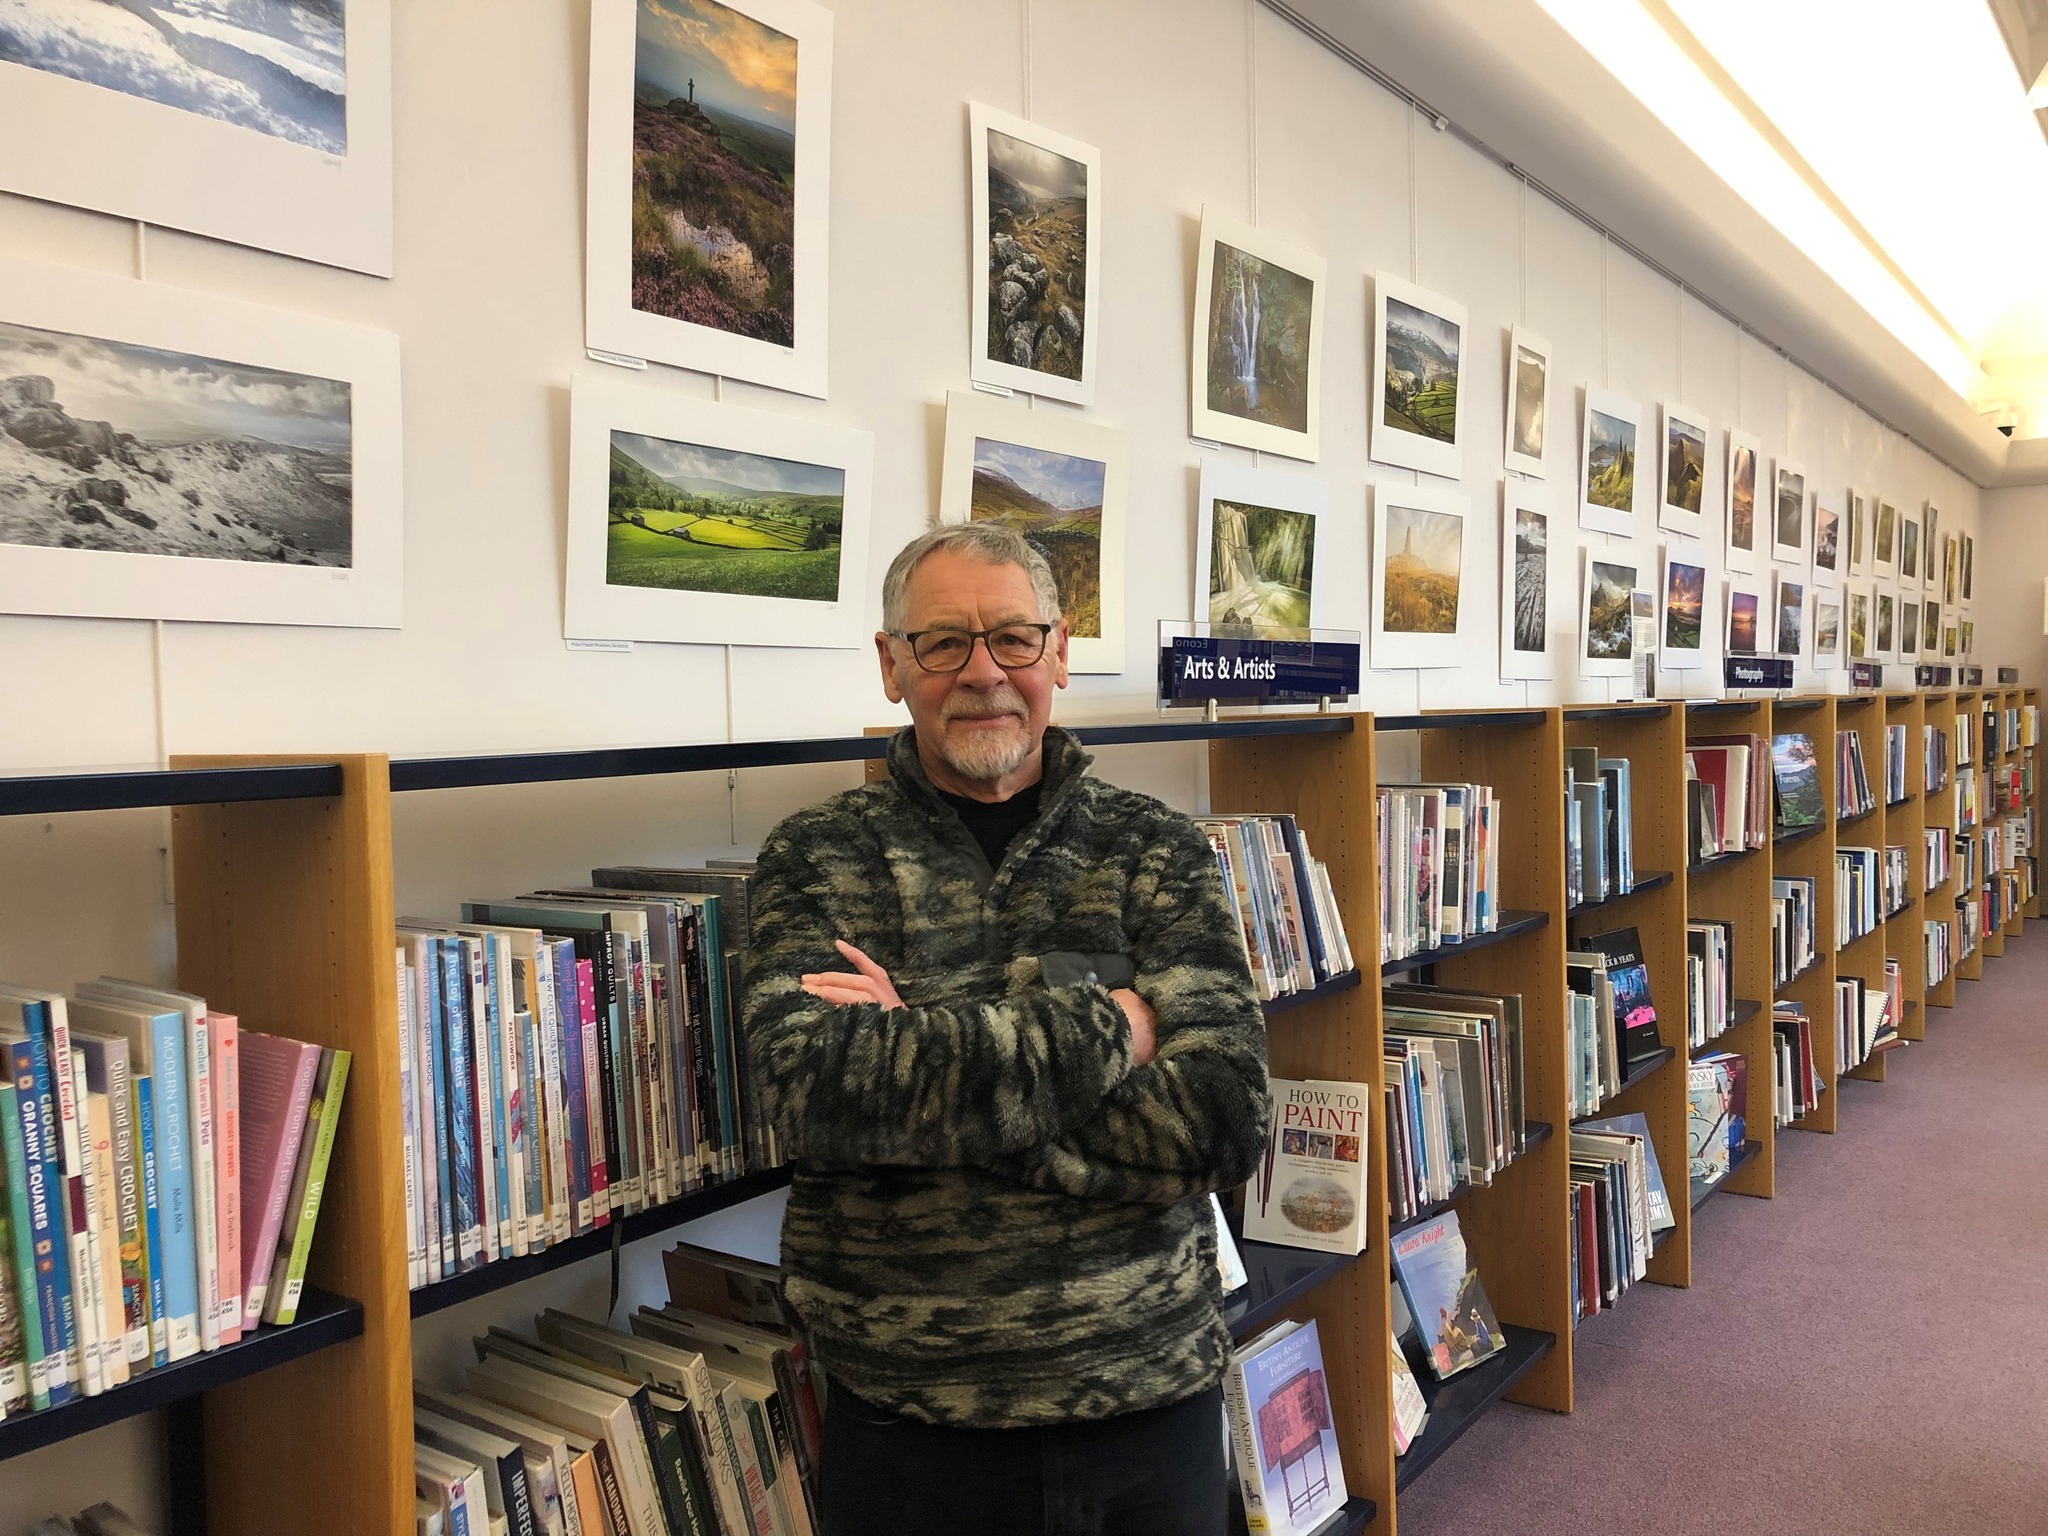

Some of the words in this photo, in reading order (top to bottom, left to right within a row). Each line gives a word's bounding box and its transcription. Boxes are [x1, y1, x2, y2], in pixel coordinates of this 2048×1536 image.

[1183, 656, 1214, 680] Arts
[1217, 656, 1230, 680] &
[1233, 656, 1276, 680] Artists
[1735, 666, 1764, 683] Photography
[1779, 775, 1800, 784] Forests
[429, 953, 438, 969] big
[448, 952, 459, 976] The
[605, 931, 613, 965] IMPROV
[1619, 953, 1636, 965] YEATS
[487, 953, 496, 977] LITTLE
[561, 959, 574, 992] Simple
[397, 962, 406, 1016] QUILTING
[431, 971, 440, 996] stitch
[449, 979, 460, 1001] Joy
[488, 979, 498, 1005] QUILTS
[452, 1006, 460, 1018] of
[547, 994, 555, 1017] CUTE
[564, 994, 577, 1028] Shapes
[55, 1026, 67, 1049] QUICK
[399, 1020, 407, 1061] BASICS
[450, 1023, 462, 1053] Jelly
[490, 1014, 499, 1035] GIFTS
[541, 1007, 550, 1047] Beginner's
[32, 1032, 48, 1067] HOW
[196, 1030, 207, 1075] Crochet
[478, 1019, 486, 1090] scandinavian
[508, 1022, 516, 1072] PATCHWORK
[587, 1033, 595, 1076] QUILTING
[693, 1027, 702, 1057] Quarter
[59, 1058, 70, 1077] EASY
[163, 1035, 178, 1100] MODERN
[454, 1057, 465, 1088] Rolls
[567, 1031, 581, 1086] Spectacular
[37, 1072, 51, 1090] TO
[110, 1060, 127, 1099] Quick
[297, 1056, 316, 1104] Crochet
[1688, 1071, 1713, 1081] INSKY
[59, 1080, 76, 1122] Crochet
[198, 1077, 209, 1118] Kawaii
[438, 1095, 446, 1128] CAROLYN
[480, 1093, 489, 1118] QUILT
[571, 1088, 583, 1119] Quilts
[1289, 1089, 1331, 1106] HOW
[1336, 1094, 1359, 1109] TO
[39, 1094, 55, 1164] CROCHET
[116, 1102, 129, 1127] and
[142, 1101, 152, 1133] HOW
[290, 1103, 306, 1136] from
[456, 1110, 465, 1140] Carolyn
[528, 1105, 539, 1138] Simple
[1284, 1104, 1362, 1132] PAINT
[23, 1100, 39, 1162] GRANNY
[94, 1140, 109, 1151] 9
[115, 1130, 130, 1162] Easy
[143, 1135, 153, 1149] TO
[167, 1103, 180, 1172] CROCHET
[201, 1120, 211, 1145] Pets
[440, 1130, 448, 1161] FORSTER
[482, 1121, 491, 1148] STYLE
[282, 1136, 299, 1168] Start
[404, 1145, 412, 1177] MICHAEL
[529, 1139, 541, 1182] Quilting
[144, 1151, 157, 1209] CROCHET
[279, 1168, 291, 1183] to
[29, 1164, 48, 1231] SQUARES
[119, 1163, 138, 1232] CROCHET
[172, 1187, 181, 1211] Molla
[270, 1184, 288, 1223] Finish
[303, 1179, 322, 1221] WILD
[406, 1179, 414, 1209] CAPUTO
[1648, 1190, 1662, 1204] TAV
[174, 1211, 183, 1234] Mills
[1650, 1205, 1667, 1221] IMT
[1397, 1237, 1419, 1256] Laura
[1422, 1223, 1445, 1244] Knight
[61, 1295, 75, 1328] EMMA
[1257, 1351, 1282, 1372] BRITISH
[1283, 1334, 1310, 1355] ANTIQUE
[1270, 1352, 1303, 1378] FURNITURE
[695, 1367, 714, 1422] SPACE
[710, 1423, 734, 1486] WORKS
[771, 1406, 782, 1427] THE
[1226, 1392, 1242, 1453] FURNITURE
[1233, 1373, 1246, 1415] BRITISH
[1240, 1420, 1257, 1471] ANTIQUE
[717, 1402, 728, 1438] GREEN
[726, 1438, 741, 1480] DESIGN
[559, 1463, 573, 1500] KELLY
[600, 1458, 609, 1475] THE
[673, 1458, 691, 1496] Rewild
[683, 1494, 697, 1519] Your
[745, 1463, 765, 1508] VINTAGE
[755, 1507, 773, 1536] HOME
[604, 1475, 628, 1536] HANDMADE
[643, 1503, 660, 1536] THIS
